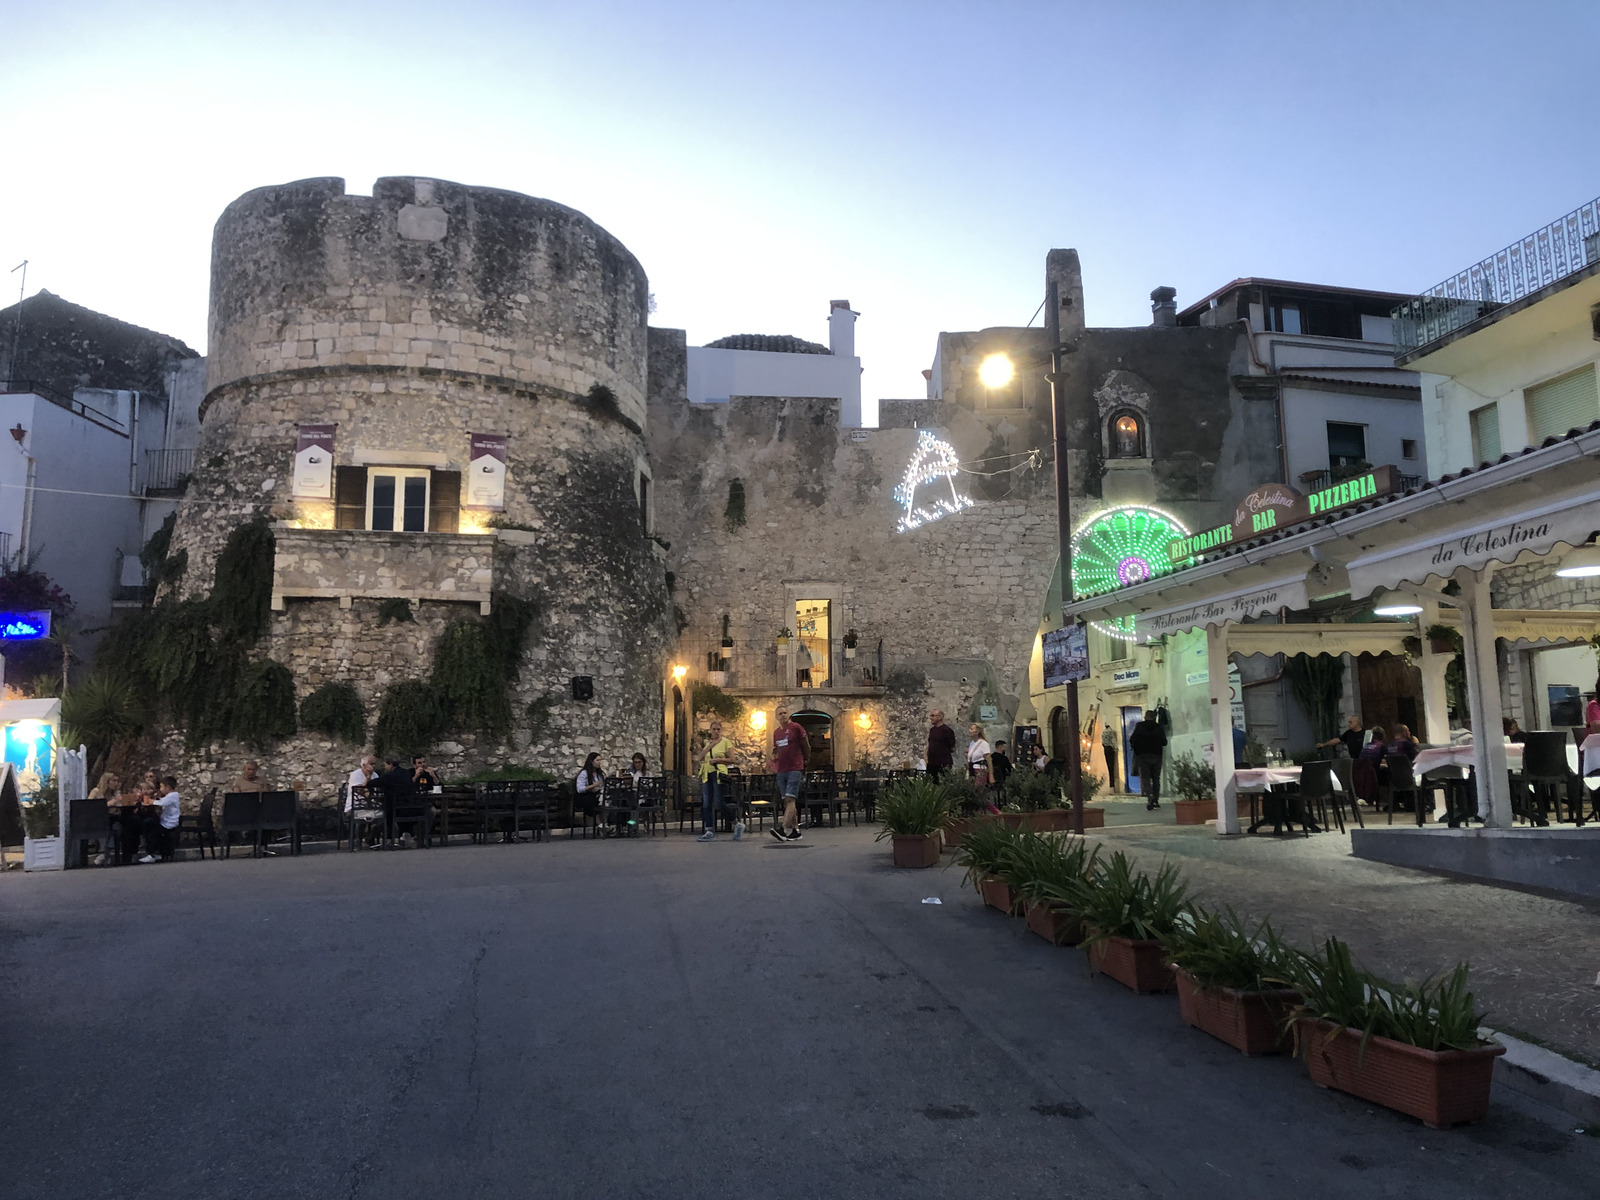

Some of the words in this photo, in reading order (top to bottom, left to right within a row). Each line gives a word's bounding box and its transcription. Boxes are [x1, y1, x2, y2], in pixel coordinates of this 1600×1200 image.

[1234, 508, 1247, 527] da
[1245, 490, 1295, 513] Celestina
[1308, 474, 1378, 515] PIZZERIA
[1252, 509, 1277, 533] BAR
[1171, 523, 1233, 560] RISTORANTE
[1431, 543, 1454, 565] da
[1460, 522, 1551, 557] Celestina
[1151, 607, 1200, 630] Ristorante
[1202, 603, 1225, 618] Bar
[1231, 590, 1278, 615] Pizzeria
[1125, 670, 1140, 679] Mare
